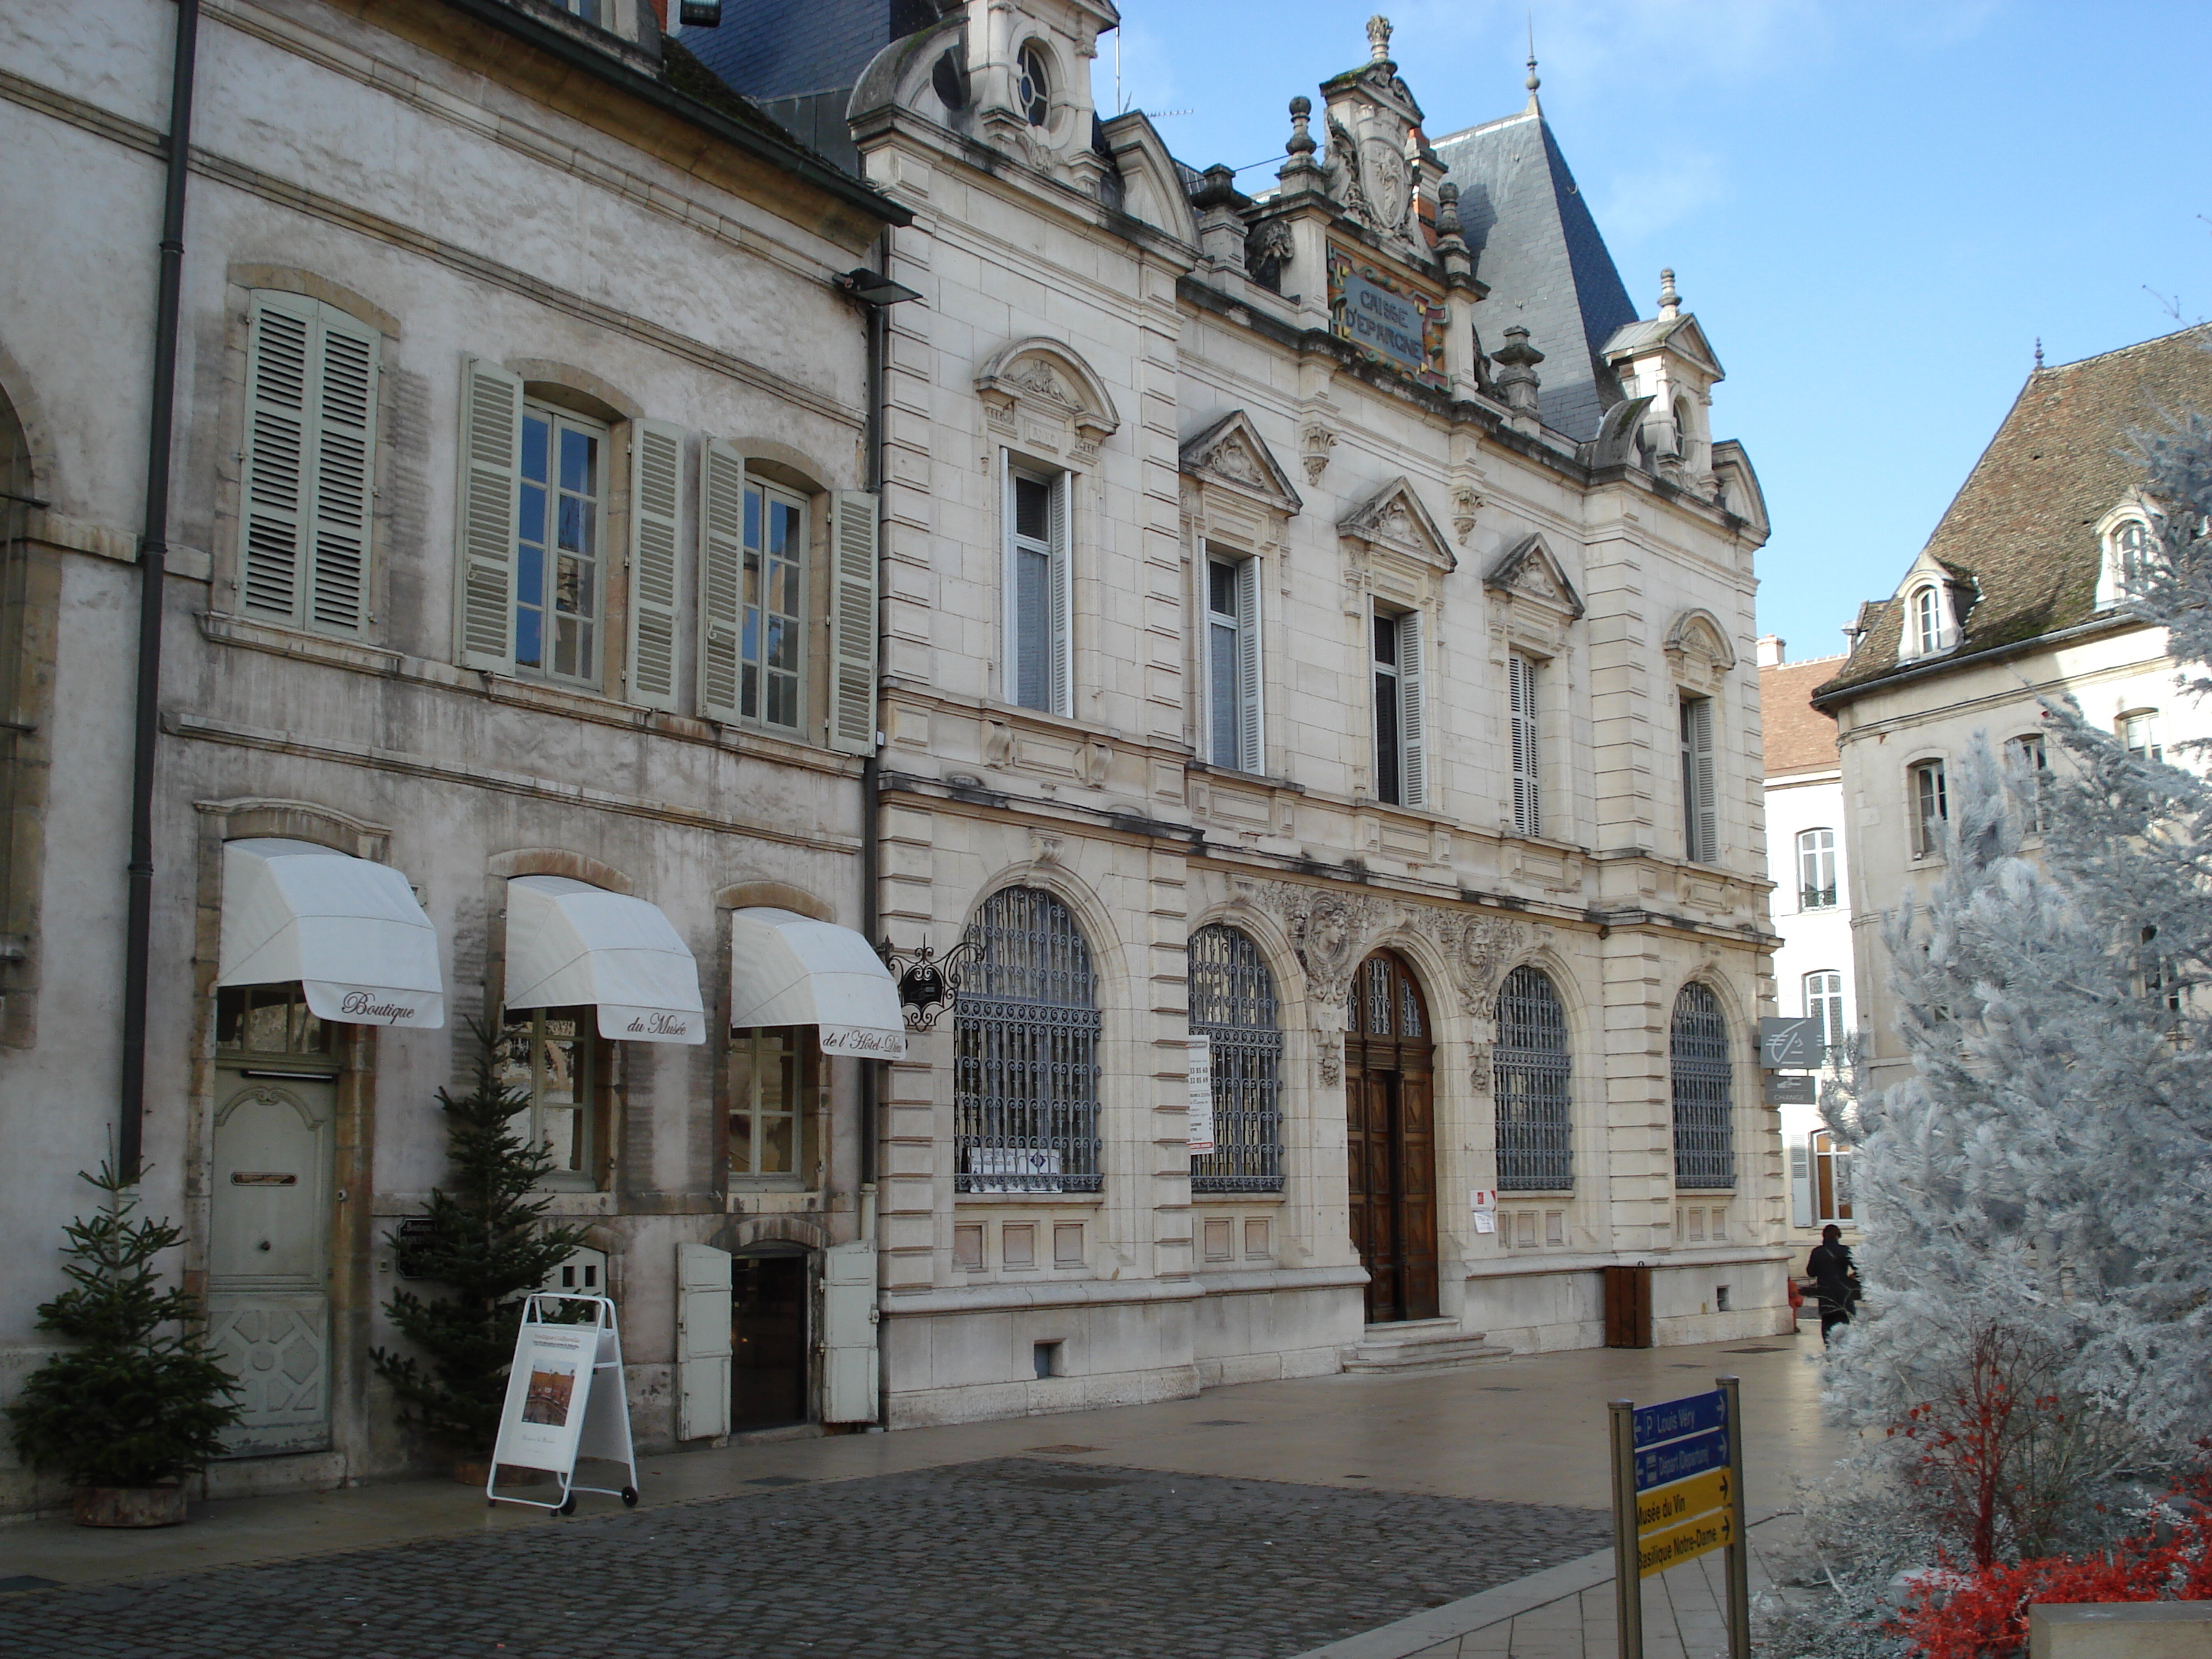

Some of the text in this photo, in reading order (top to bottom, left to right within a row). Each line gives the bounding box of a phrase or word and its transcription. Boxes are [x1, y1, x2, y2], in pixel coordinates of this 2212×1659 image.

[1360, 289, 1408, 328] CAISSE
[341, 991, 415, 1025] Boutique
[626, 1012, 687, 1035] du Musée
[822, 1033, 837, 1047] de
[1646, 1415, 1653, 1437] P
[1656, 1411, 1678, 1434] Louis
[1663, 1498, 1672, 1518] du
[1673, 1493, 1685, 1514] Vin
[1673, 1527, 1717, 1557] Notre-Dame
